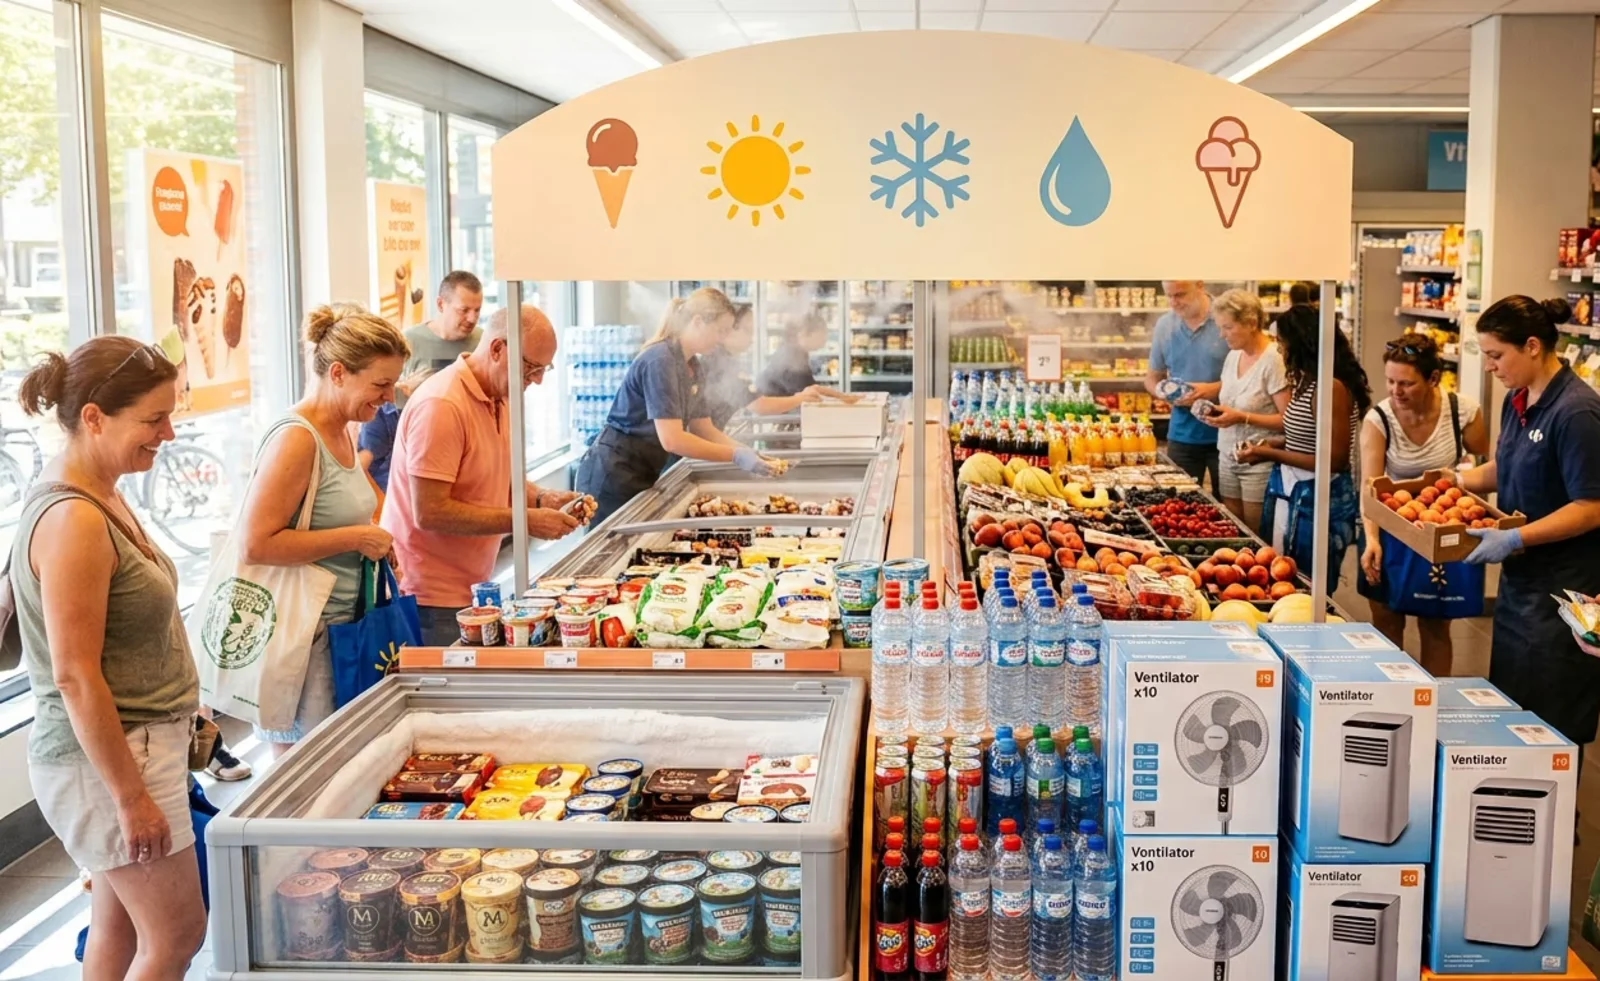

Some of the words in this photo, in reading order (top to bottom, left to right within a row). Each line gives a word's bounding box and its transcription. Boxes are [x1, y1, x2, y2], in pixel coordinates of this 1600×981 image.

[1134, 671, 1200, 683] Ventilator
[1133, 686, 1158, 698] x10
[1130, 860, 1155, 872] x10
[1308, 871, 1362, 881] Ventilator
